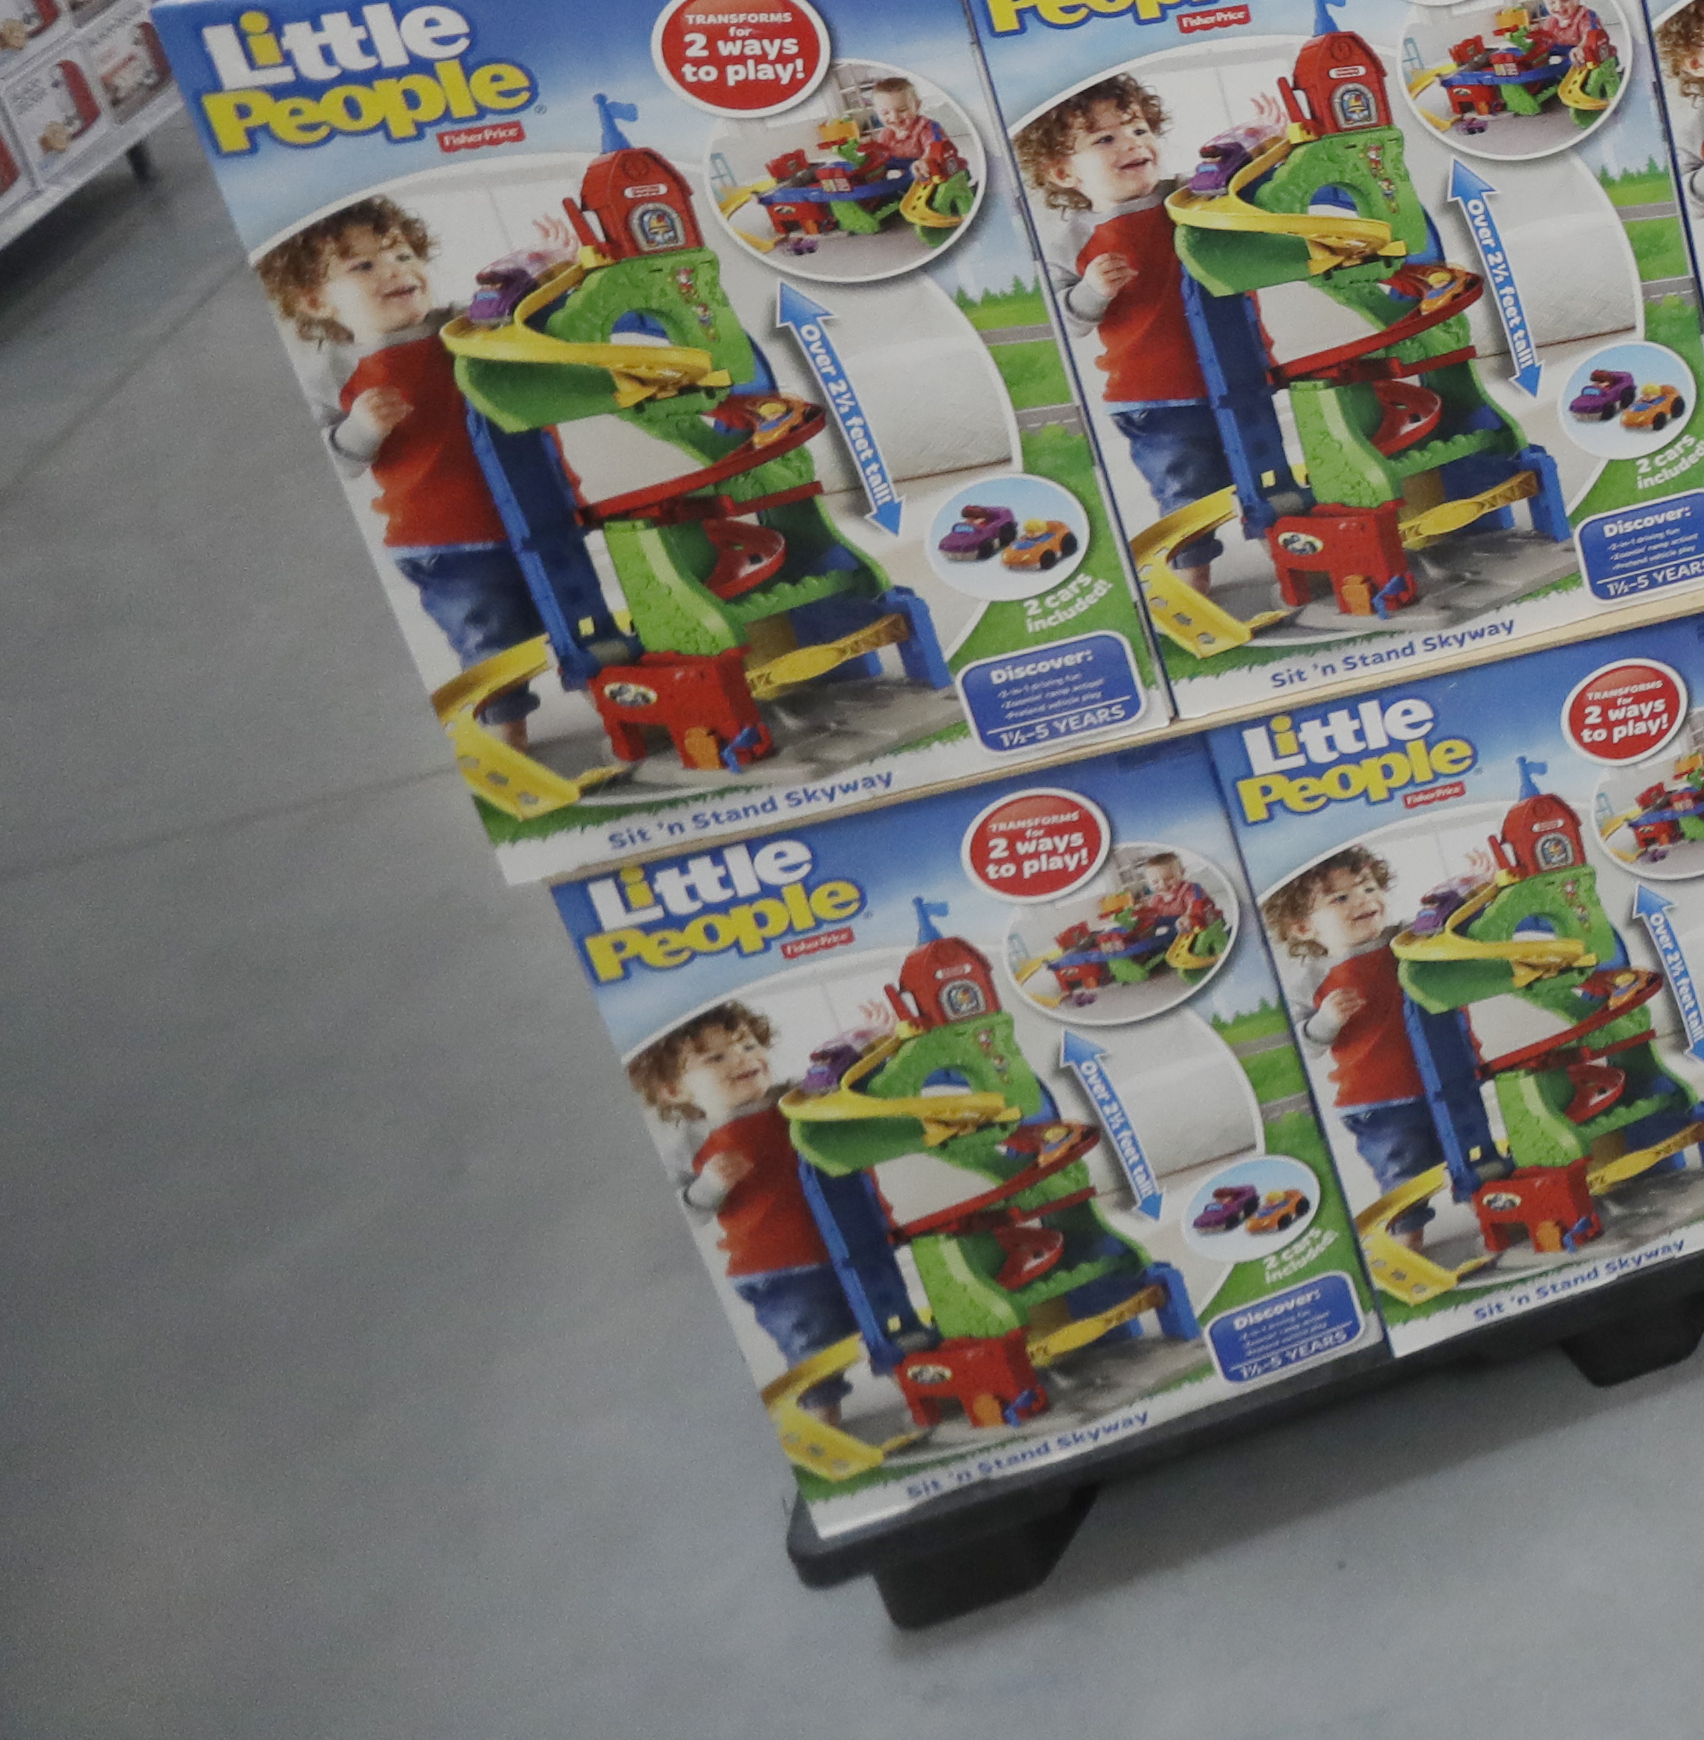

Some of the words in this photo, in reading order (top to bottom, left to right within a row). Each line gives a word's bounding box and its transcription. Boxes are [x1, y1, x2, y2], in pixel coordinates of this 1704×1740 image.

[681, 11, 791, 25] TRANSFORMS
[724, 26, 752, 39] for
[1181, 9, 1246, 30] Fisher-Price
[197, 1, 471, 94] Little
[680, 30, 710, 57] 2
[712, 35, 800, 61] ways
[679, 61, 719, 82] to
[722, 56, 805, 87] play!
[196, 58, 531, 156] People
[442, 125, 520, 148] Fisher-Price
[1467, 198, 1497, 247] Over
[1499, 283, 1525, 328] feet
[1513, 328, 1536, 369] tall!
[800, 324, 840, 375] Over
[846, 414, 880, 462] feet
[866, 461, 895, 506] tall!
[1634, 456, 1653, 477] 2
[1653, 435, 1696, 468] cars
[1601, 505, 1692, 540] Discover:
[1022, 597, 1045, 618] 2
[1044, 573, 1094, 609] cars
[1025, 578, 1114, 633] included!
[988, 648, 1096, 686] Discover:
[1267, 668, 1306, 690] Sit
[1340, 639, 1416, 673] Stand
[1420, 616, 1512, 652] Skyway
[1051, 703, 1127, 734] YEARS
[1237, 700, 1435, 780] Little
[1231, 737, 1474, 826] People
[601, 827, 647, 850] Sit
[687, 795, 776, 832] Stand
[780, 768, 889, 808] Skyway
[584, 844, 812, 935] Little
[582, 880, 860, 984] People
